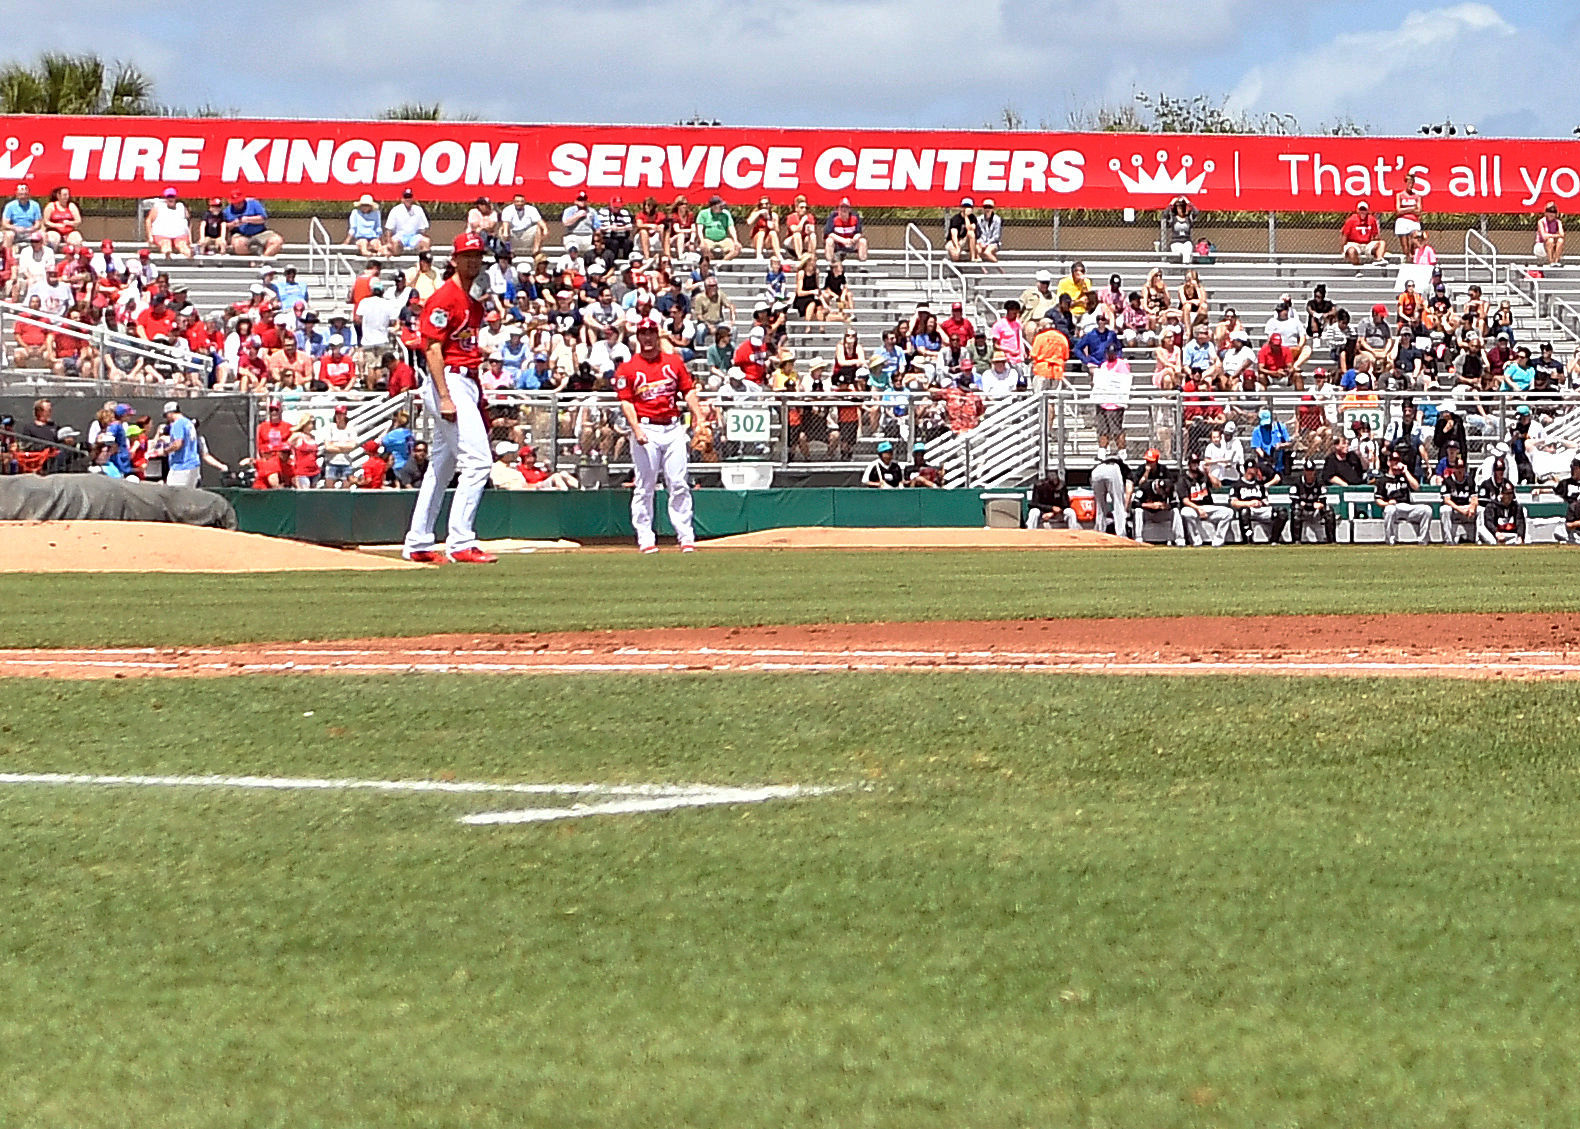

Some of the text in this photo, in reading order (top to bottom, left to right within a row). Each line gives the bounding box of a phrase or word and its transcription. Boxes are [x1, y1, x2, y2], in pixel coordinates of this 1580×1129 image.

[62, 135, 1086, 194] TIRE KINGDOM SERVICE CENTERS
[1278, 153, 1432, 197] That's
[1449, 154, 1501, 198] all
[730, 414, 765, 433] 302
